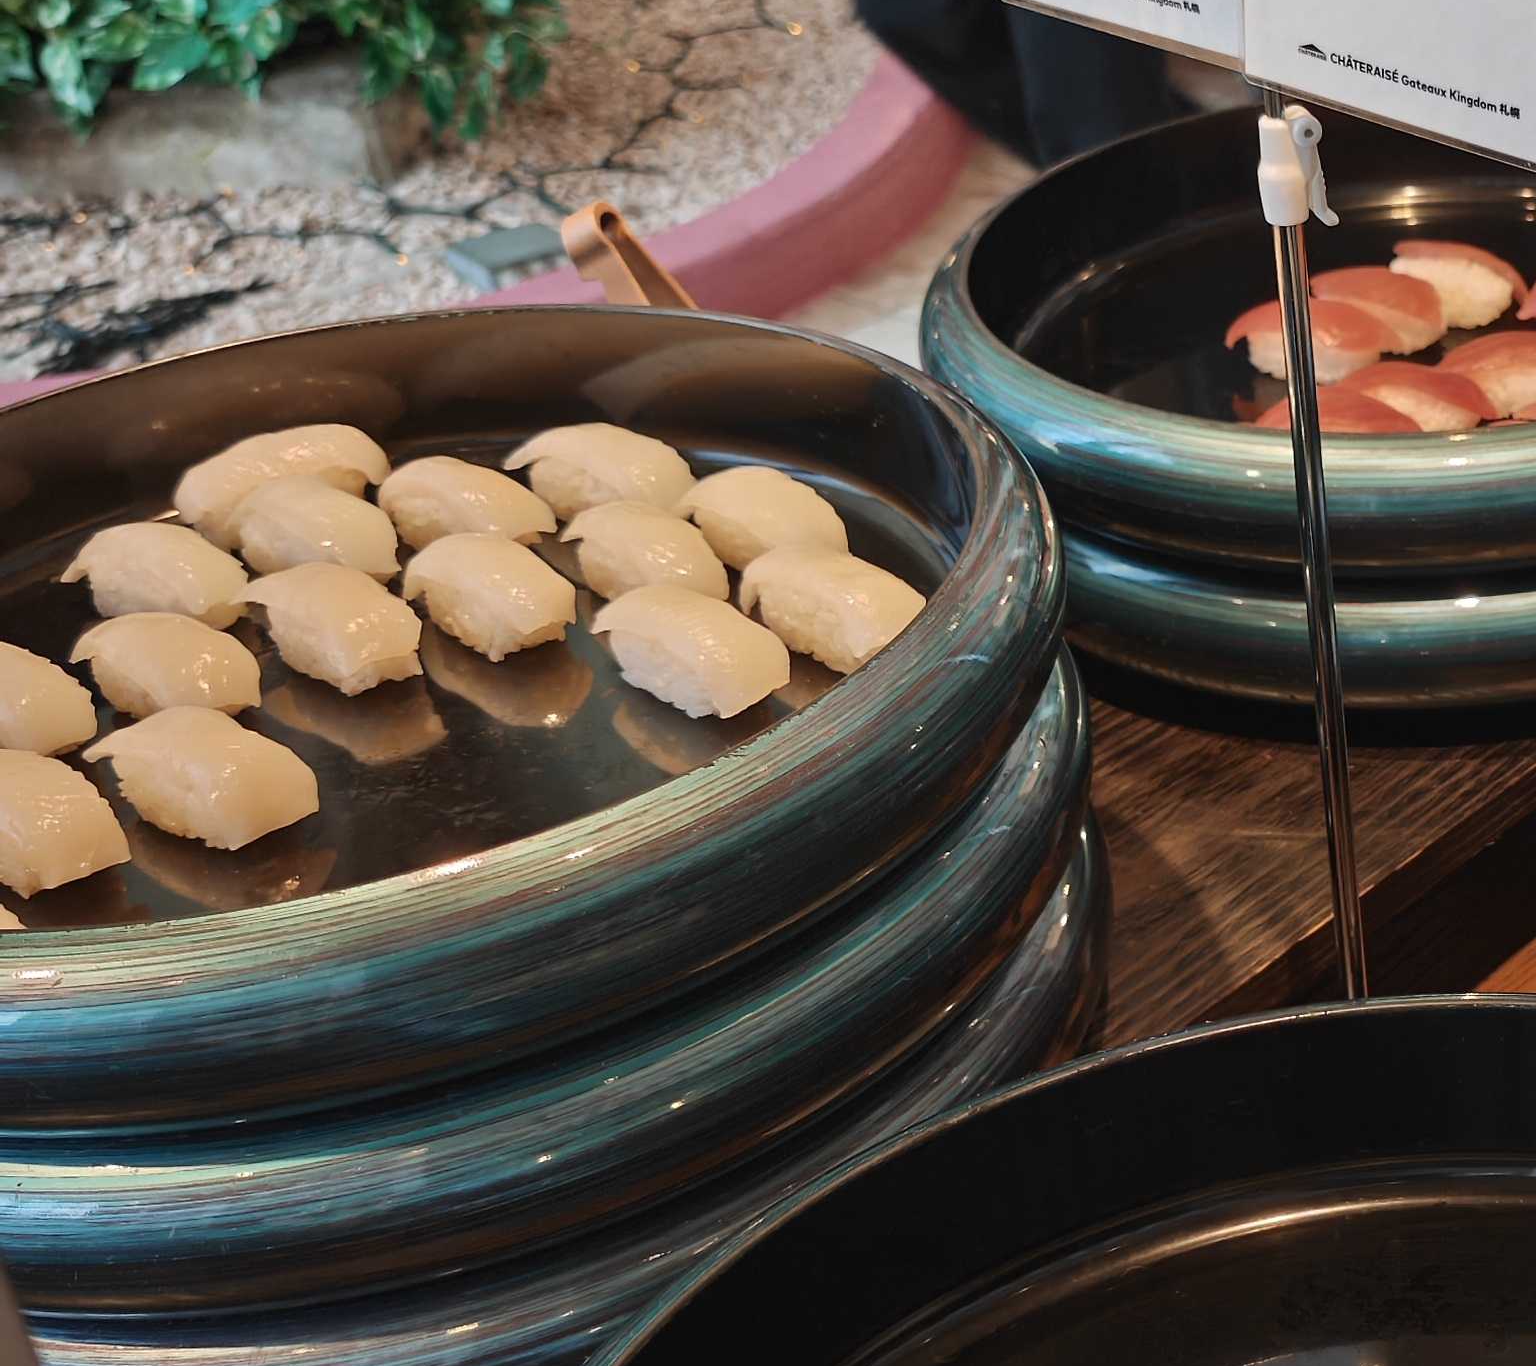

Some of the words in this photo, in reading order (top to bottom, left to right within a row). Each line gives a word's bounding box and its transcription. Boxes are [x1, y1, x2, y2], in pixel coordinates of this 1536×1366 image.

[1329, 52, 1399, 83] CHÂTERAISÉ
[1401, 74, 1447, 98] Gateaux
[1449, 88, 1498, 113] Kingdom
